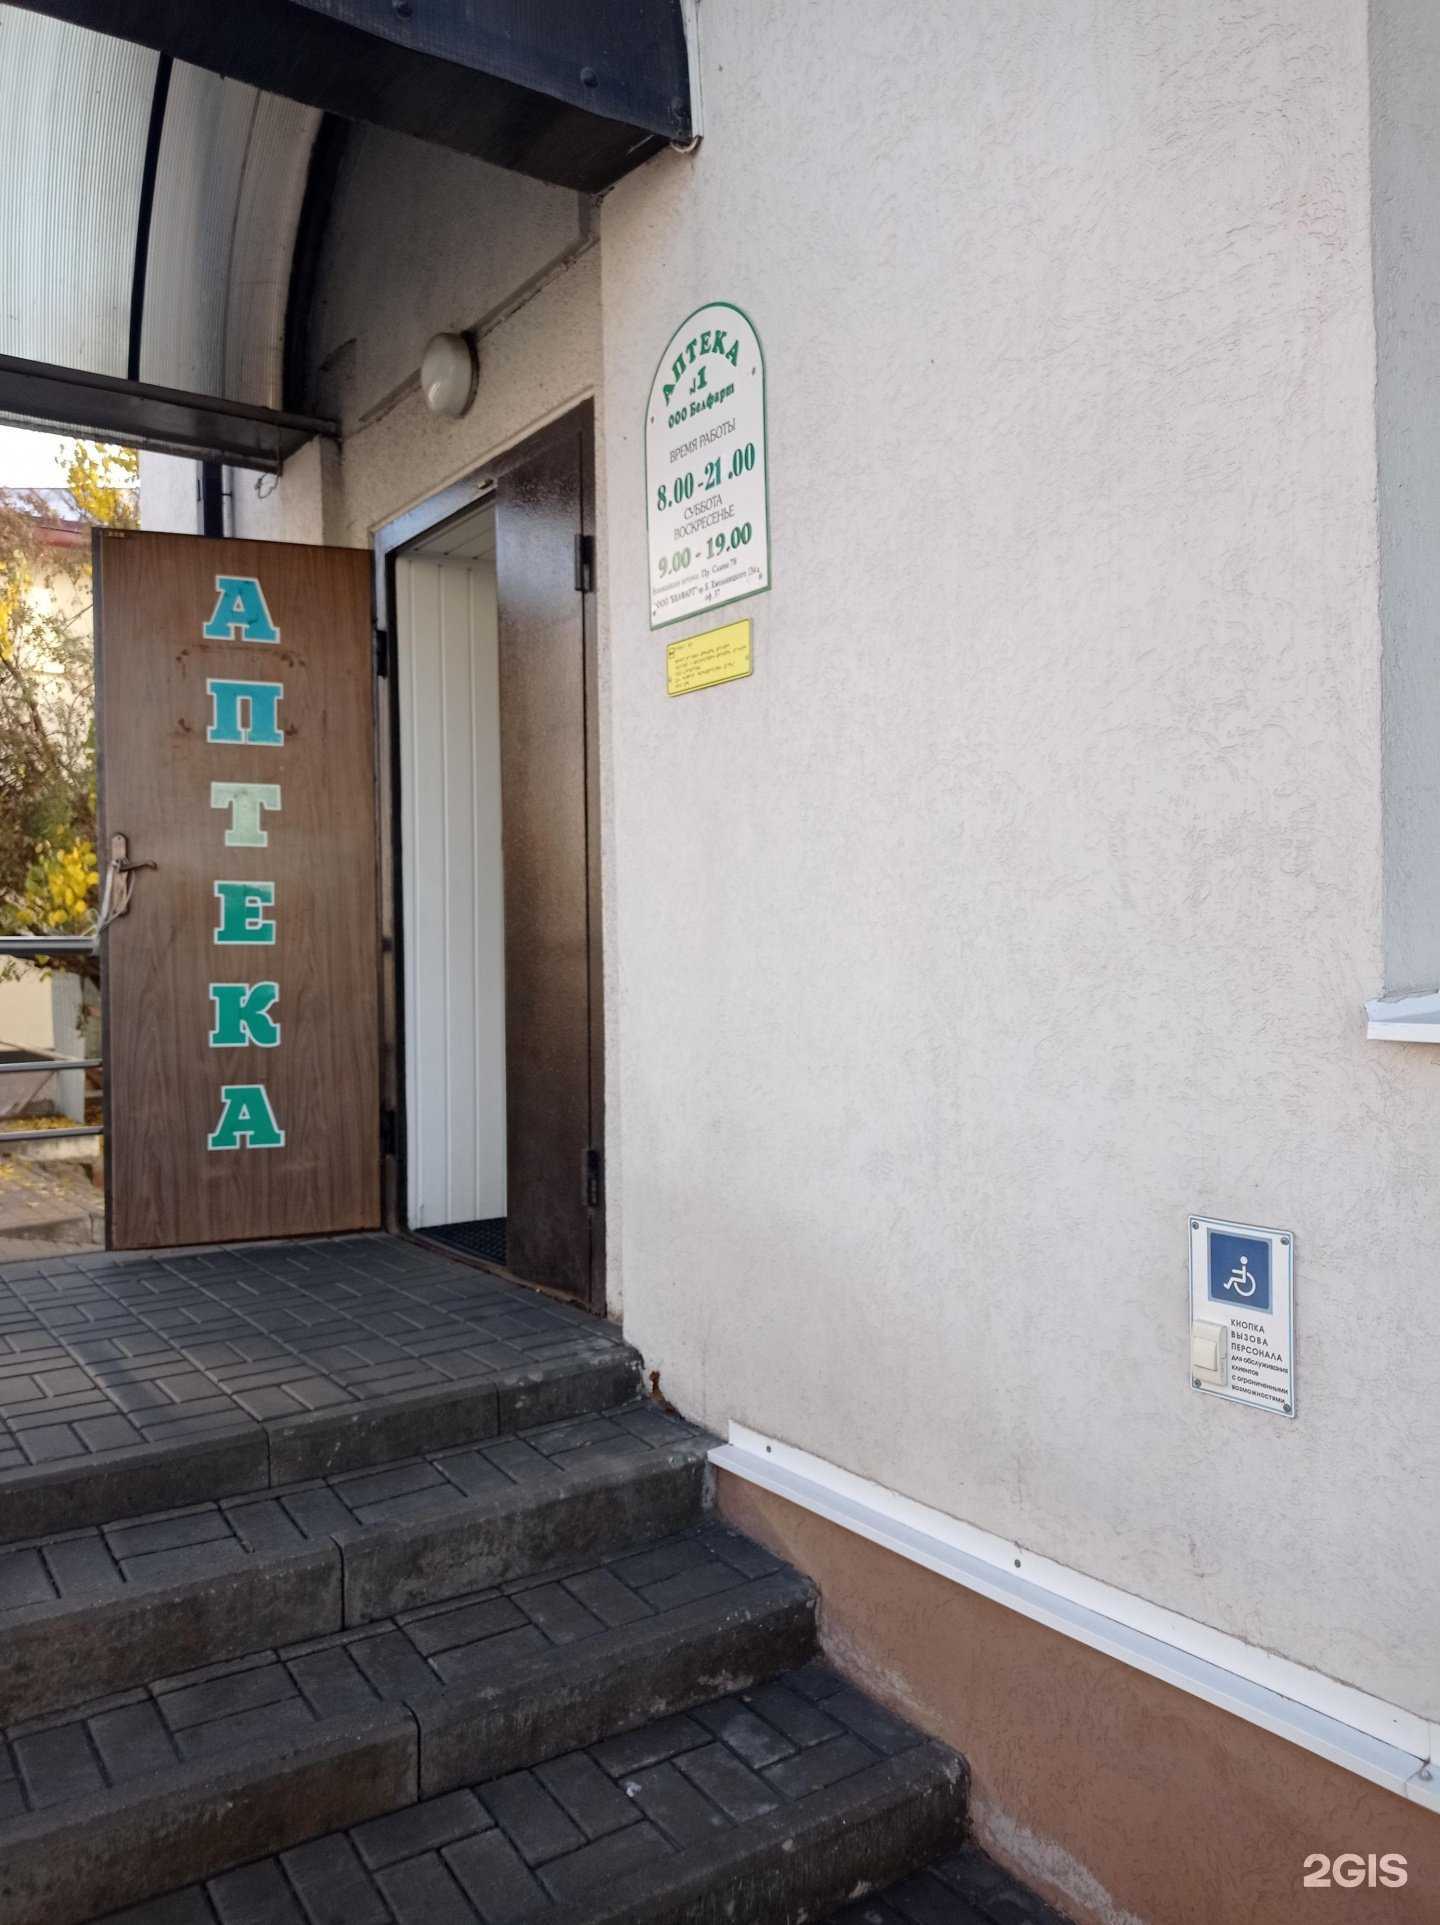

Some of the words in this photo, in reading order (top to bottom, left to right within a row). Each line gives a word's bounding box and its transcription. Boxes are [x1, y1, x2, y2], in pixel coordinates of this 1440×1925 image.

[663, 330, 739, 407] АПТЕКА
[668, 407, 688, 429] ООО
[670, 437, 698, 464] ВРЕМЯ
[699, 417, 737, 449] РАБОТЫ
[683, 493, 724, 520] СУББОТА
[673, 503, 736, 541] ВОСКРЕСЕНЬЕ
[203, 575, 286, 1150] АПТЕКА
[1230, 1319, 1265, 1334] КНОПКА
[1231, 1330, 1269, 1347] ВЫЗОВА
[1231, 1342, 1283, 1362] ПЕРСОНАЛА
